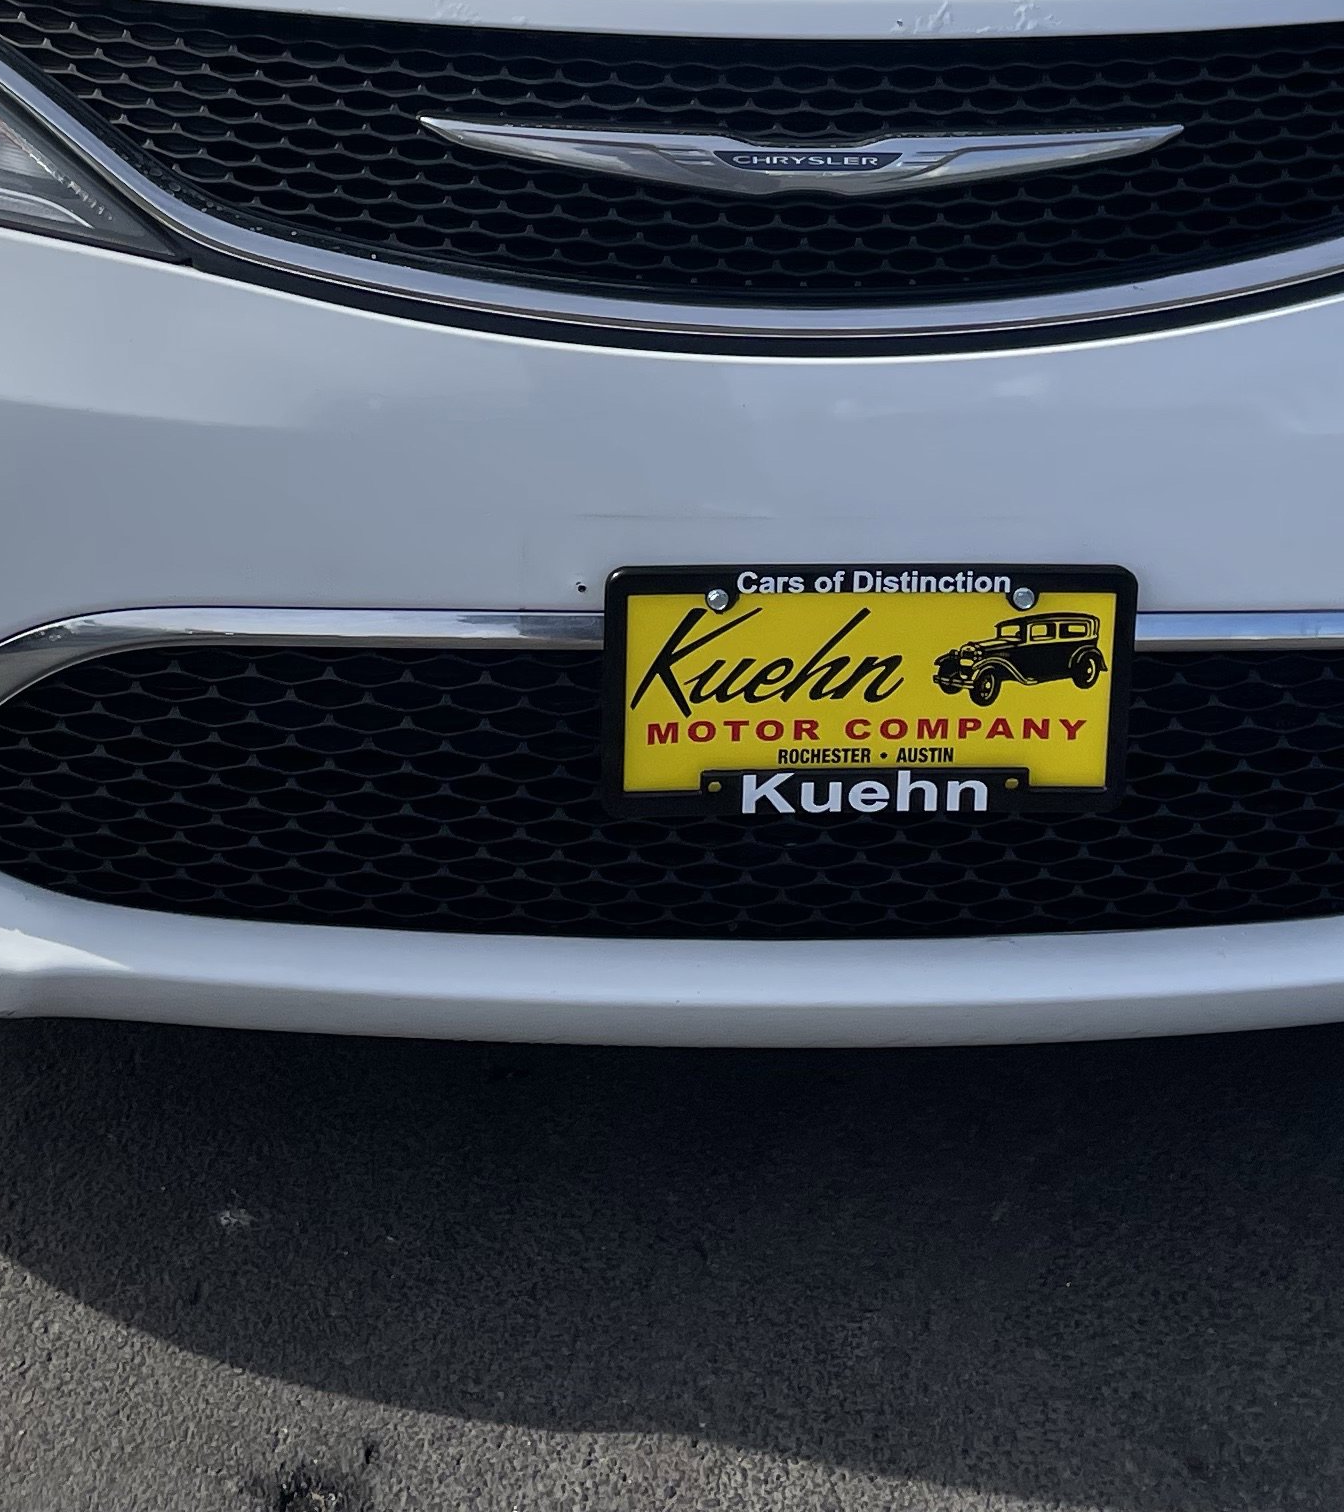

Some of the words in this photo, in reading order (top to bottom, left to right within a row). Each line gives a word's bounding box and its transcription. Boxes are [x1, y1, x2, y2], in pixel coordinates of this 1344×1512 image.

[732, 155, 878, 166] CHRYSLER
[737, 571, 805, 594] Cars
[814, 570, 846, 593] of
[852, 570, 1011, 594] Distinction
[630, 607, 905, 719] Kuehn
[647, 719, 820, 745] MOTOR
[844, 718, 1088, 740] COMPANY
[777, 748, 871, 765] ROCHESTER
[896, 747, 955, 763] AUSTIN
[741, 770, 988, 814] Kuehn
